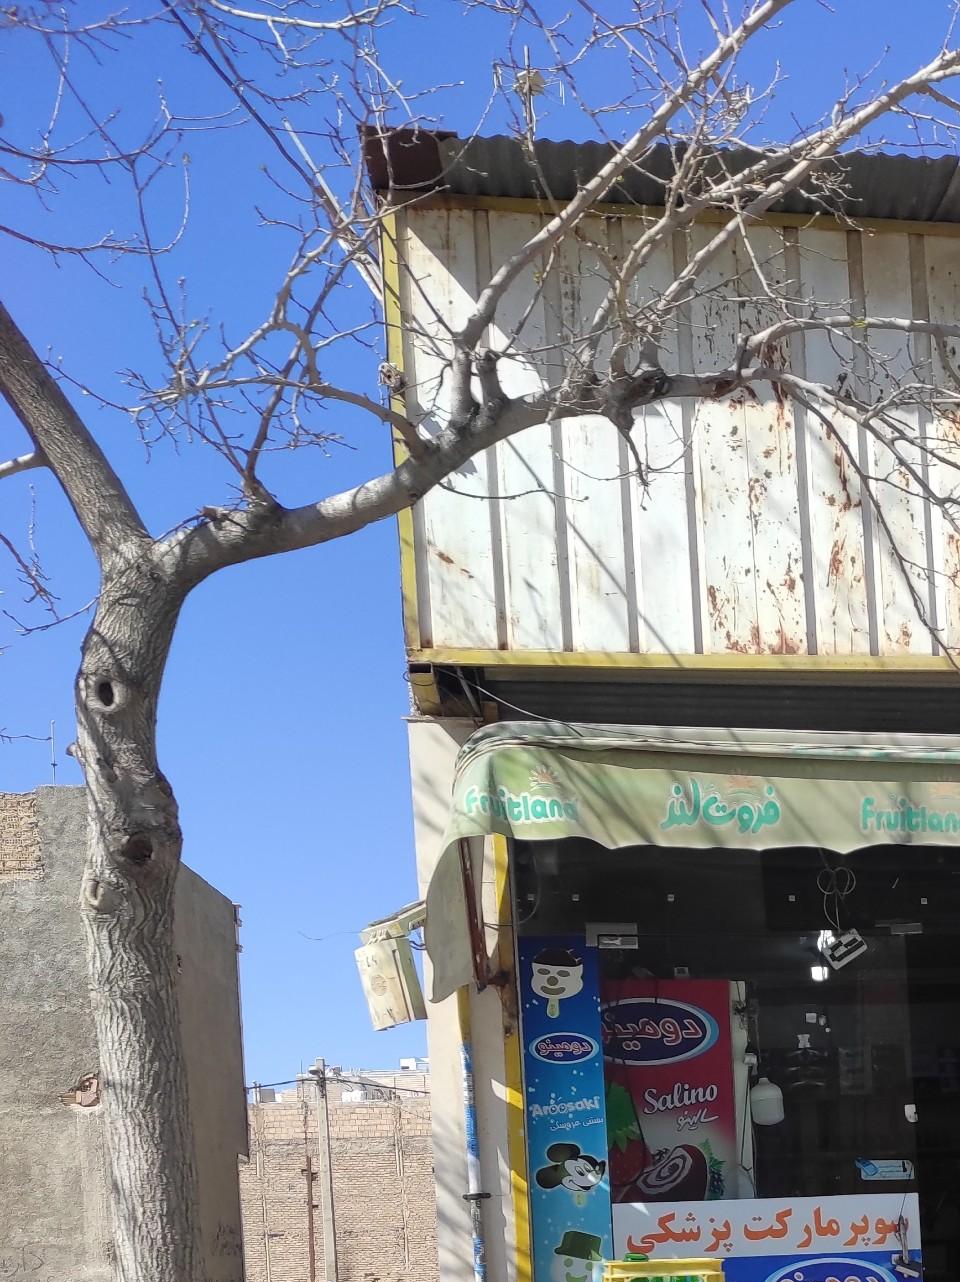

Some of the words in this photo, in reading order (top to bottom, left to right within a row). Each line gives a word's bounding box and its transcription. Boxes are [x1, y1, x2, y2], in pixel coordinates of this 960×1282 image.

[538, 1038, 592, 1058] دومینو
[644, 1082, 719, 1114] Salino
[626, 1210, 733, 1255] پزشکی
[743, 1205, 842, 1249] مارکت
